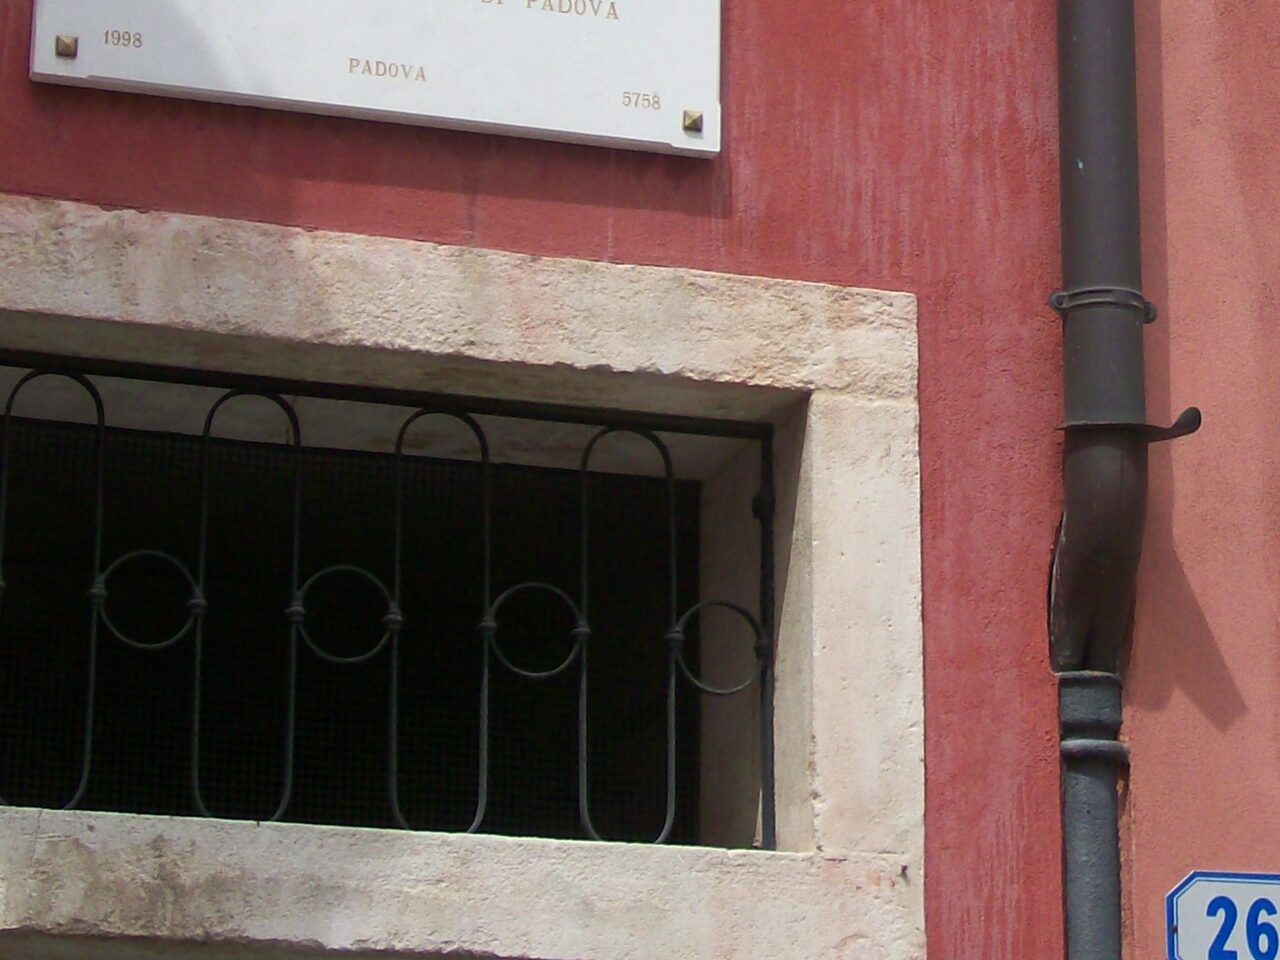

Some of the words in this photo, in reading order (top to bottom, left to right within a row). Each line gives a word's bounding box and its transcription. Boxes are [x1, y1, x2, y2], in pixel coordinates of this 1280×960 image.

[104, 29, 143, 49] 1998
[348, 57, 427, 82] PADOVA
[622, 91, 661, 110] 5758
[1205, 895, 1280, 960] 26
